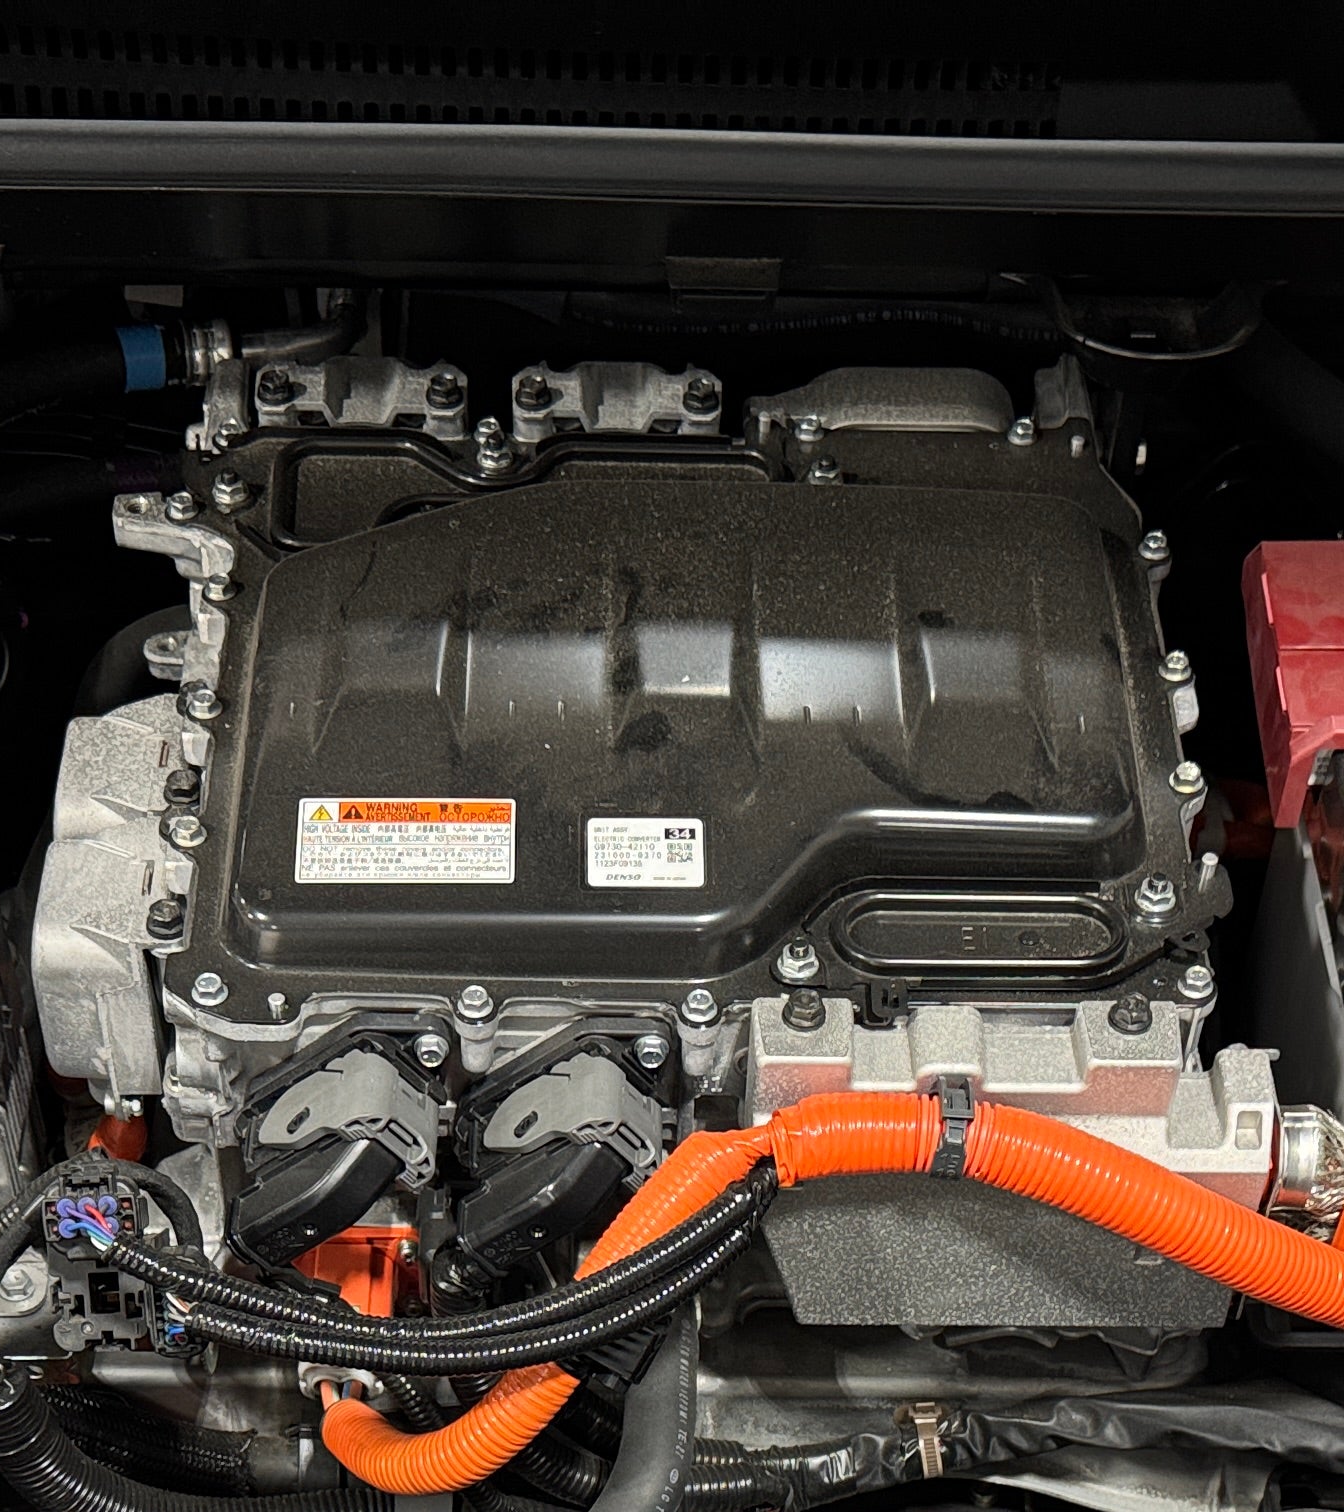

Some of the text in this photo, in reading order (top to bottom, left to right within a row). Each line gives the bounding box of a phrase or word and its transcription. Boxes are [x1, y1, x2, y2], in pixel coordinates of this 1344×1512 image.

[366, 802, 418, 813] WARNING
[366, 812, 431, 821] AVERTISSEMENT
[668, 828, 692, 839] 34
[661, 1485, 674, 1503] LC
